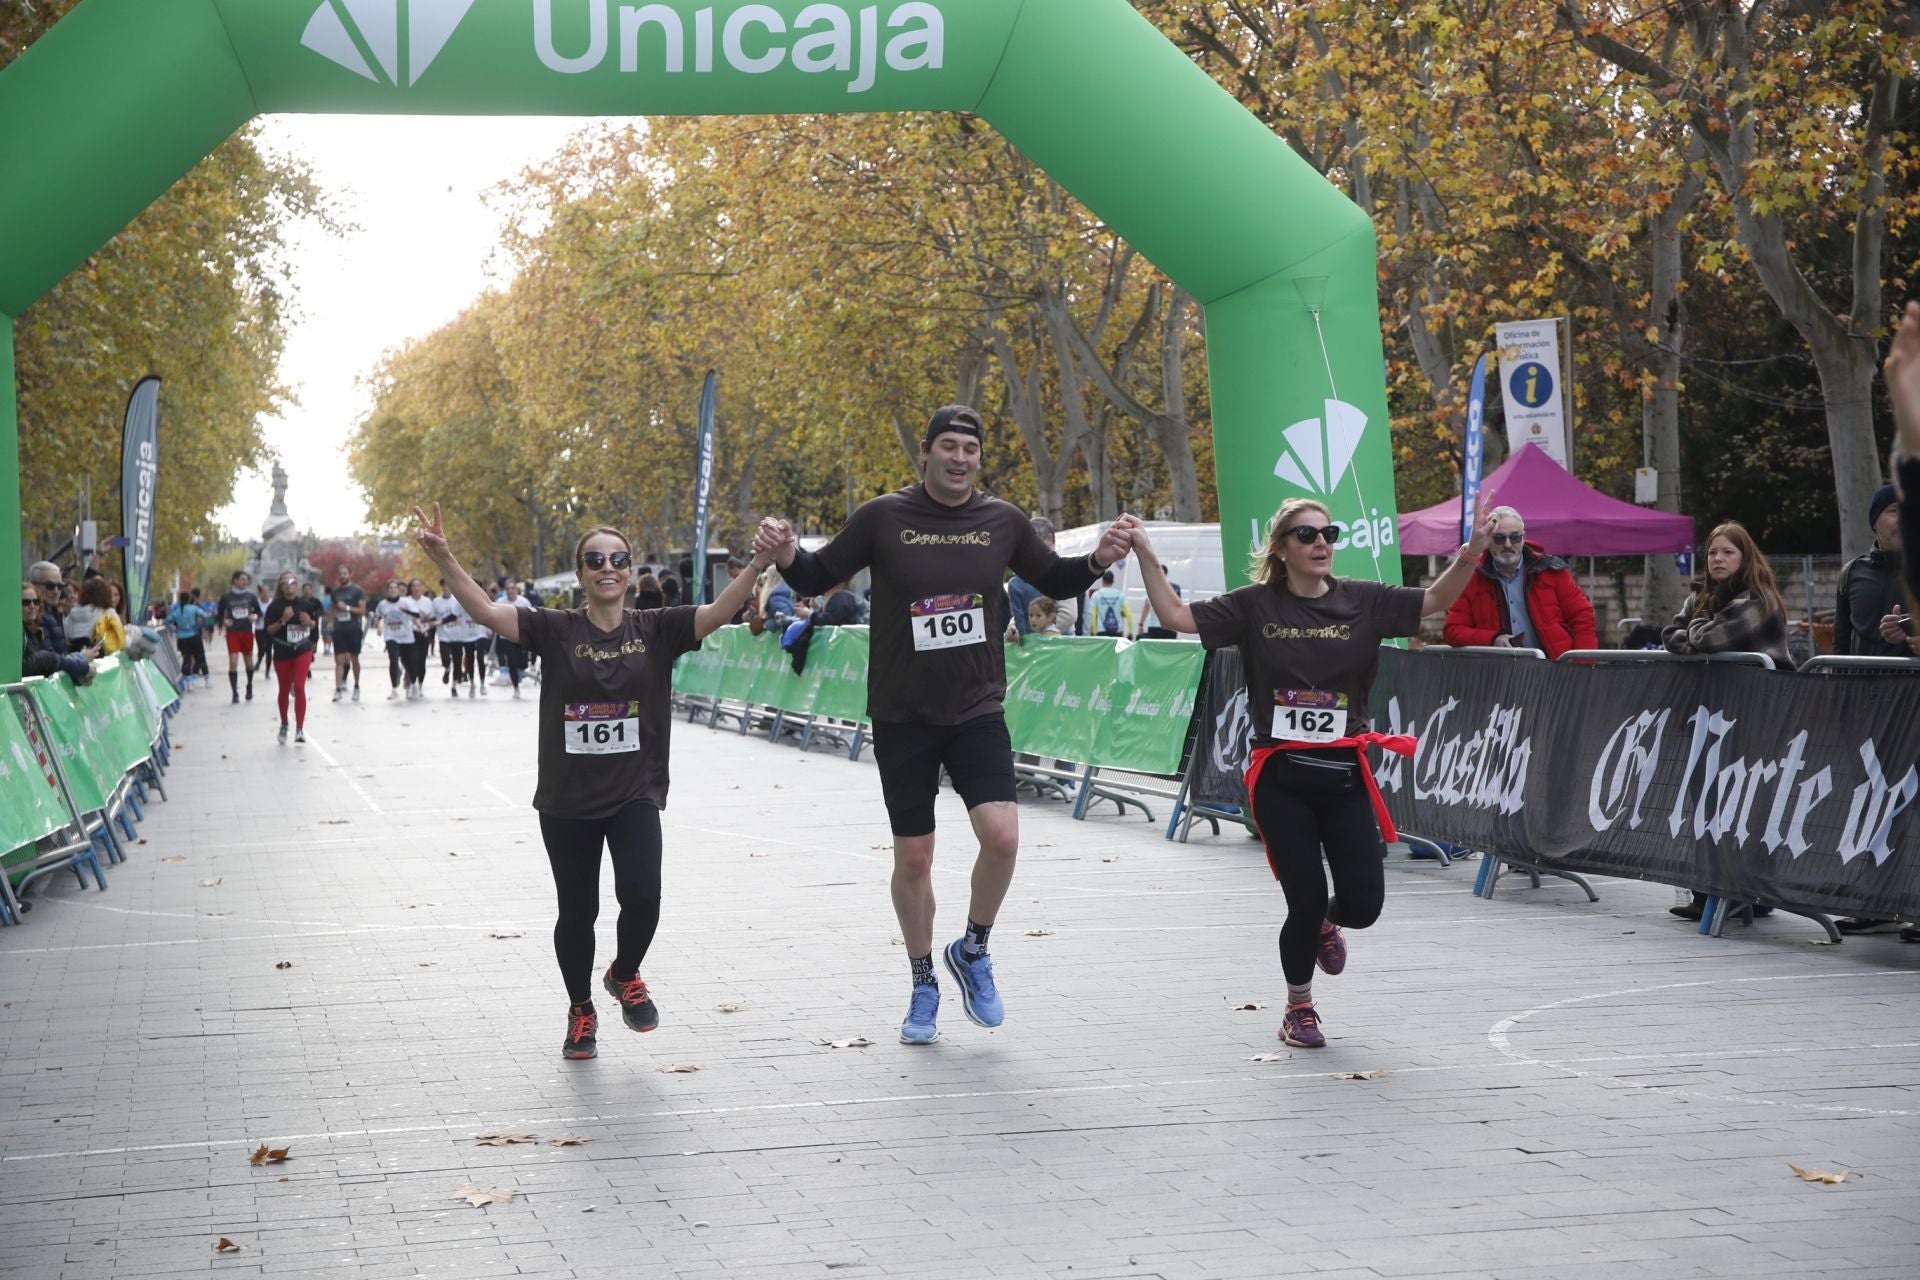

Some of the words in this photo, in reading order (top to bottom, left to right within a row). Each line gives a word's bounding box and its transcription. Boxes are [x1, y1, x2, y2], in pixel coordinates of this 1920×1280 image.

[533, 0, 944, 93] Unicaja
[1504, 331, 1530, 340] Oficina
[1531, 329, 1541, 337] de
[135, 441, 157, 563] unicaja
[924, 612, 973, 639] 160
[576, 721, 624, 743] 161
[1285, 709, 1334, 733] 162
[1414, 696, 1532, 817] Castilla
[1588, 707, 1672, 832] El
[1668, 704, 1833, 860] Norte
[1836, 737, 1919, 868] de
